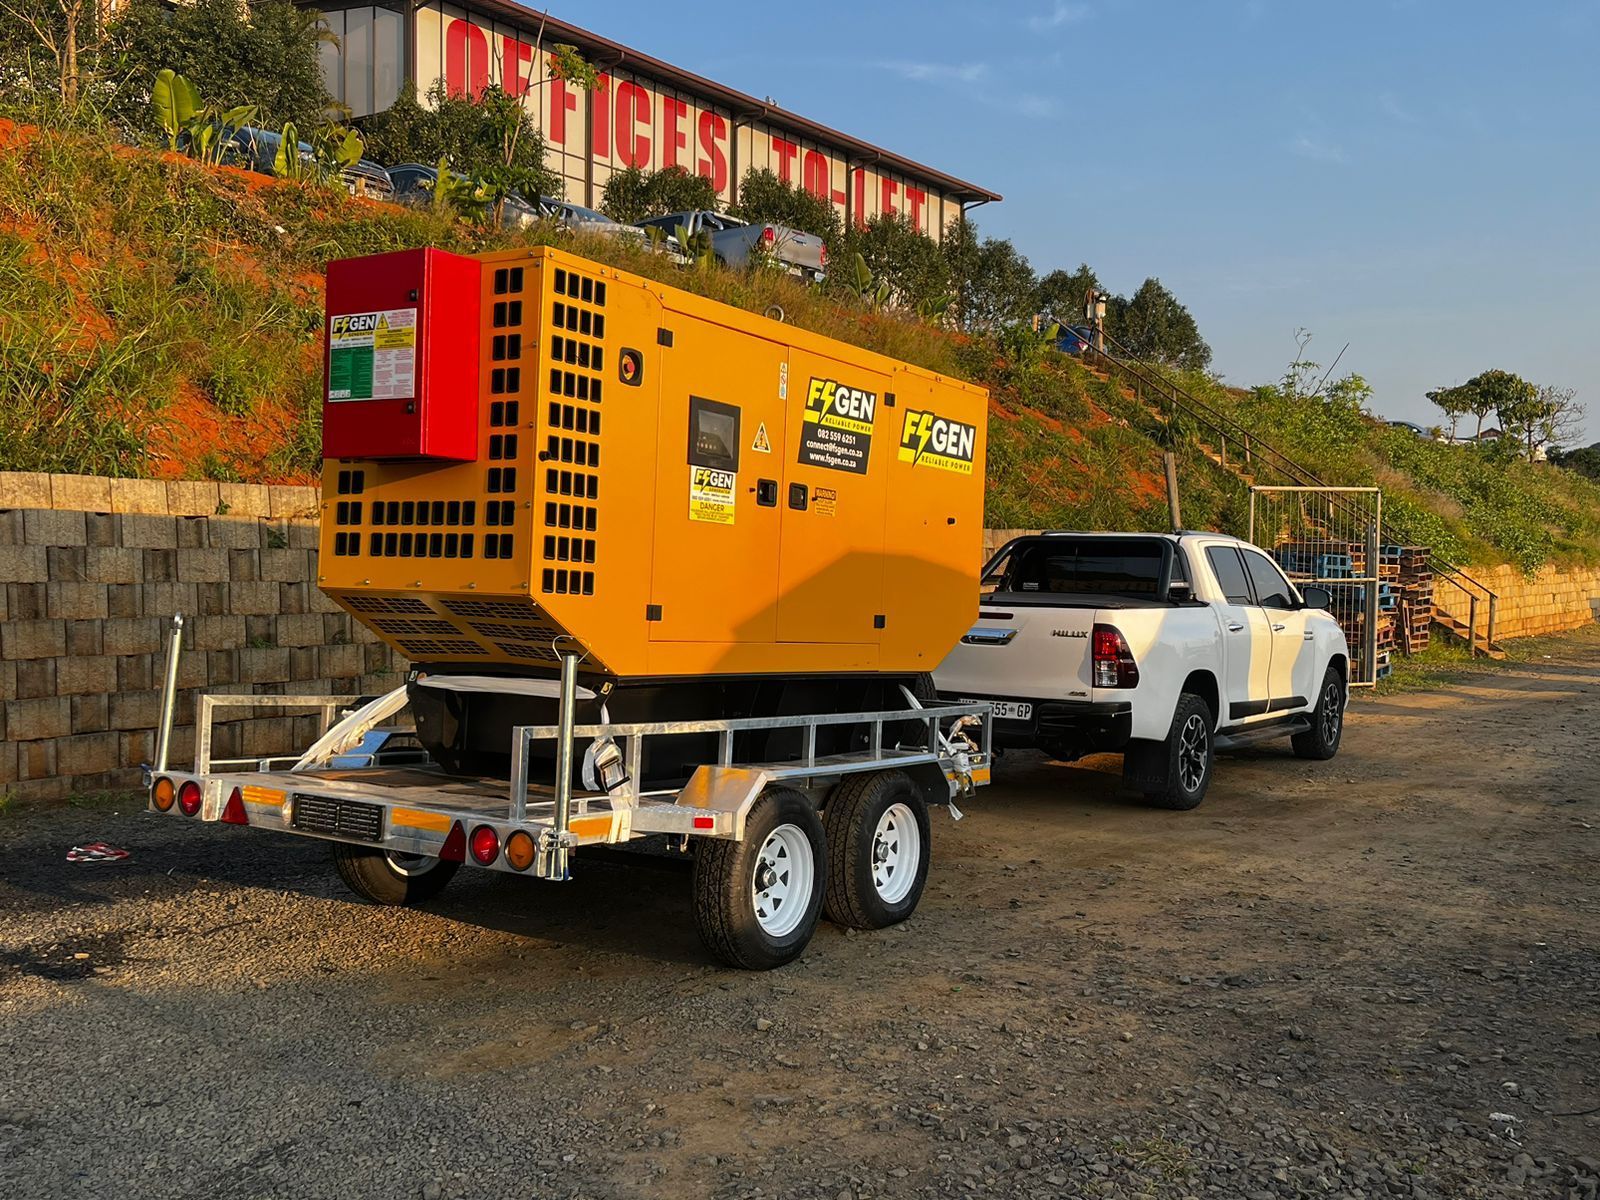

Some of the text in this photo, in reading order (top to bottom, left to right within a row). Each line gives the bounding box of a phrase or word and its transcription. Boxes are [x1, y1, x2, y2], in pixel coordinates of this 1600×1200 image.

[446, 18, 727, 193] OFFICES
[825, 416, 871, 433] RELIABLE POWER
[817, 428, 856, 445] 082 559 6251
[806, 440, 863, 458] connect@fsgen.co.za
[809, 452, 857, 468] www.fsgen.co.za
[921, 455, 971, 471] RELIABLE POWER
[699, 501, 725, 512] DANGER
[1052, 629, 1089, 639] HILUX
[1016, 704, 1031, 718] GP
